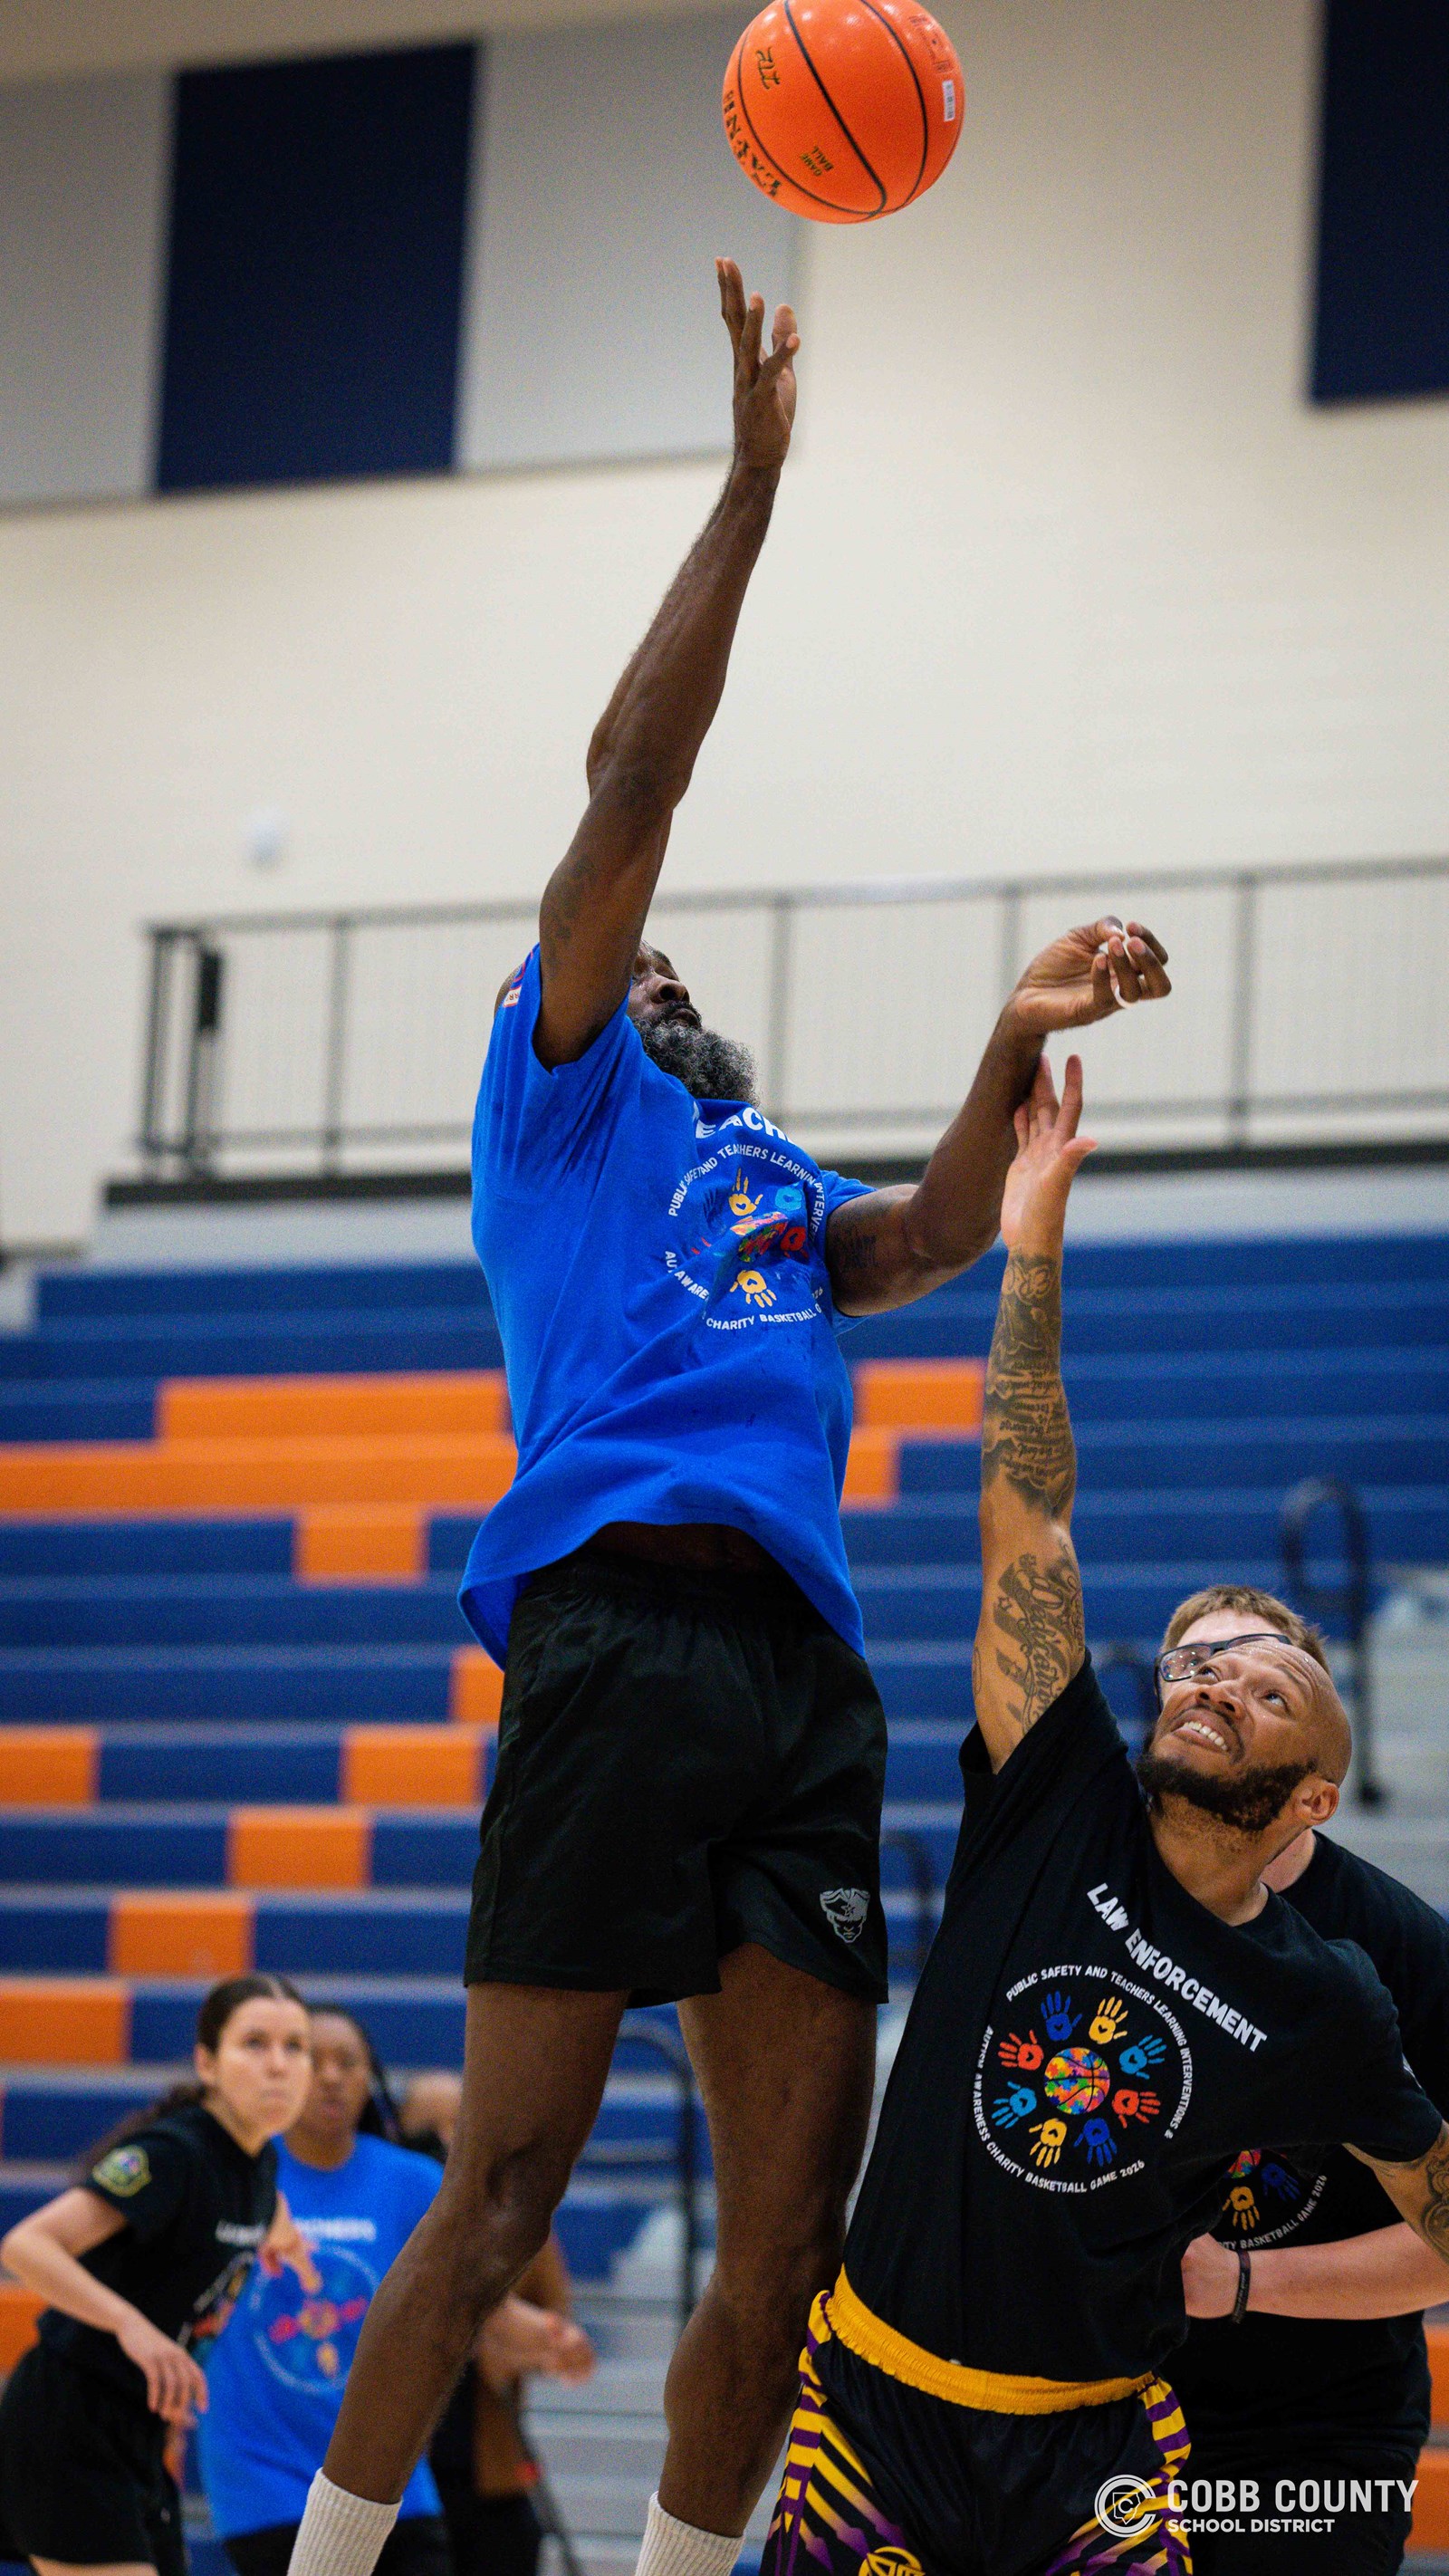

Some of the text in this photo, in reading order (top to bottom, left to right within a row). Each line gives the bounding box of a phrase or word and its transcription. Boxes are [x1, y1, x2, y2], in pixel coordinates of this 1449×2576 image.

[684, 1167, 703, 1186] SAFET
[769, 1151, 816, 1185] LEARNIN
[706, 1315, 755, 1330] CHARITY
[759, 1308, 817, 1322] BASKETBALL
[1087, 1883, 1267, 2052] LAW ENFORCEMENT
[1006, 1973, 1039, 2002] PUBLIC
[1041, 1965, 1082, 1980] SAFETY
[1085, 1966, 1108, 1979] AND
[1110, 1971, 1156, 2004] TEACHERS
[1153, 2000, 1187, 2046] LEARNING
[1170, 2047, 1193, 2129] INTERVENTIONS
[973, 2072, 992, 2141] AWARENESS
[986, 2141, 1025, 2177] CHARITY
[1024, 2172, 1088, 2193] BASKETBALL
[1089, 2171, 1118, 2190] GAME
[1119, 2159, 1146, 2177] 2026
[1240, 2219, 1300, 2249] BASKETBALL
[1297, 2198, 1318, 2222] GAME
[1312, 2175, 1328, 2197] 2026
